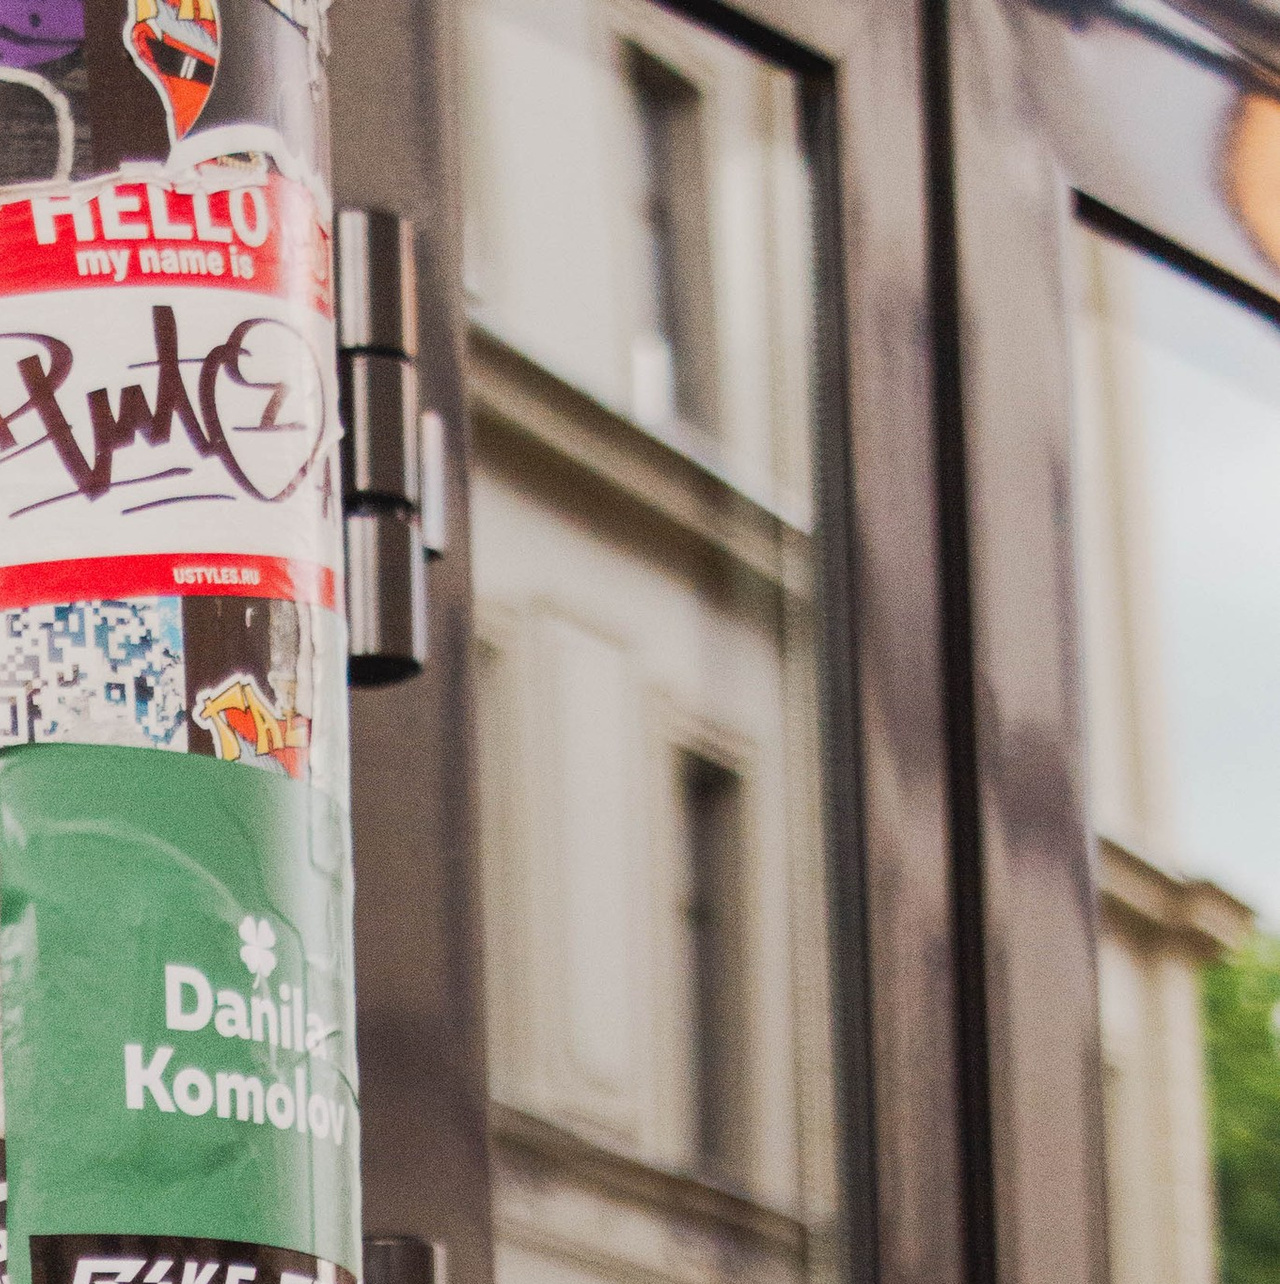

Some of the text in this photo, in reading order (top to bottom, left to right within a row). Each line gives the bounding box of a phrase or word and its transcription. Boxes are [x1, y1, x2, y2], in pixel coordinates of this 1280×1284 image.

[31, 182, 268, 248] HELLO
[75, 245, 255, 282] my name is
[165, 963, 337, 1061] Danila
[123, 1043, 346, 1146] Komolov
